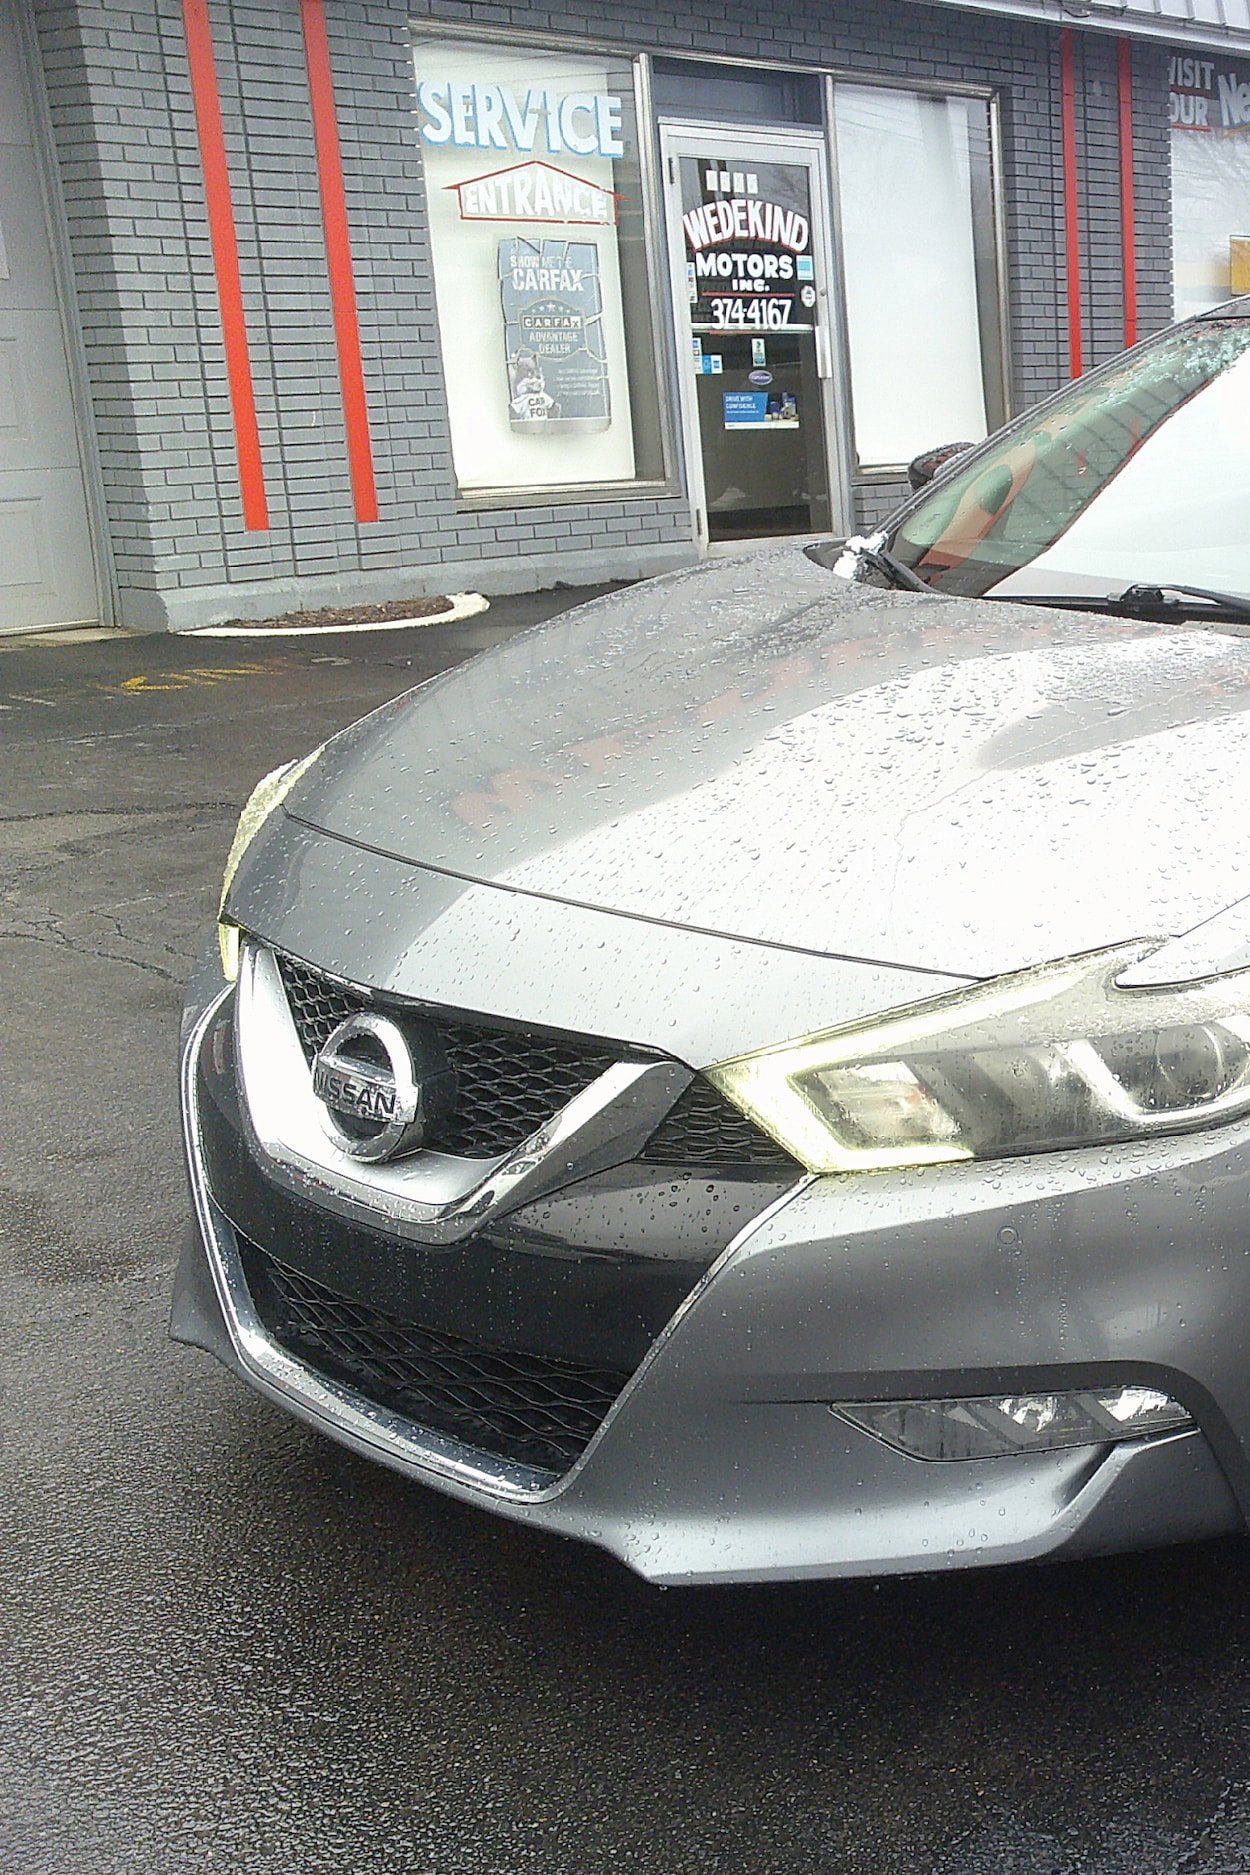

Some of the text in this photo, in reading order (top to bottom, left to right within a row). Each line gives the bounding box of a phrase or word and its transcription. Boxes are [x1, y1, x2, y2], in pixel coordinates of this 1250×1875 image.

[416, 81, 624, 158] SERVICE
[465, 168, 608, 218] ENTRANCE
[682, 199, 808, 251] WEDEKIND
[510, 255, 539, 268] SHOW
[696, 252, 794, 279] MOTORS
[513, 269, 584, 291] CARFAX
[732, 279, 770, 292] INC.
[523, 316, 581, 328] CARFAX
[711, 298, 792, 330] 374-4167
[529, 331, 578, 342] ADVANTAGE
[539, 343, 571, 353] DEALER
[313, 1068, 397, 1114] NISSAN
